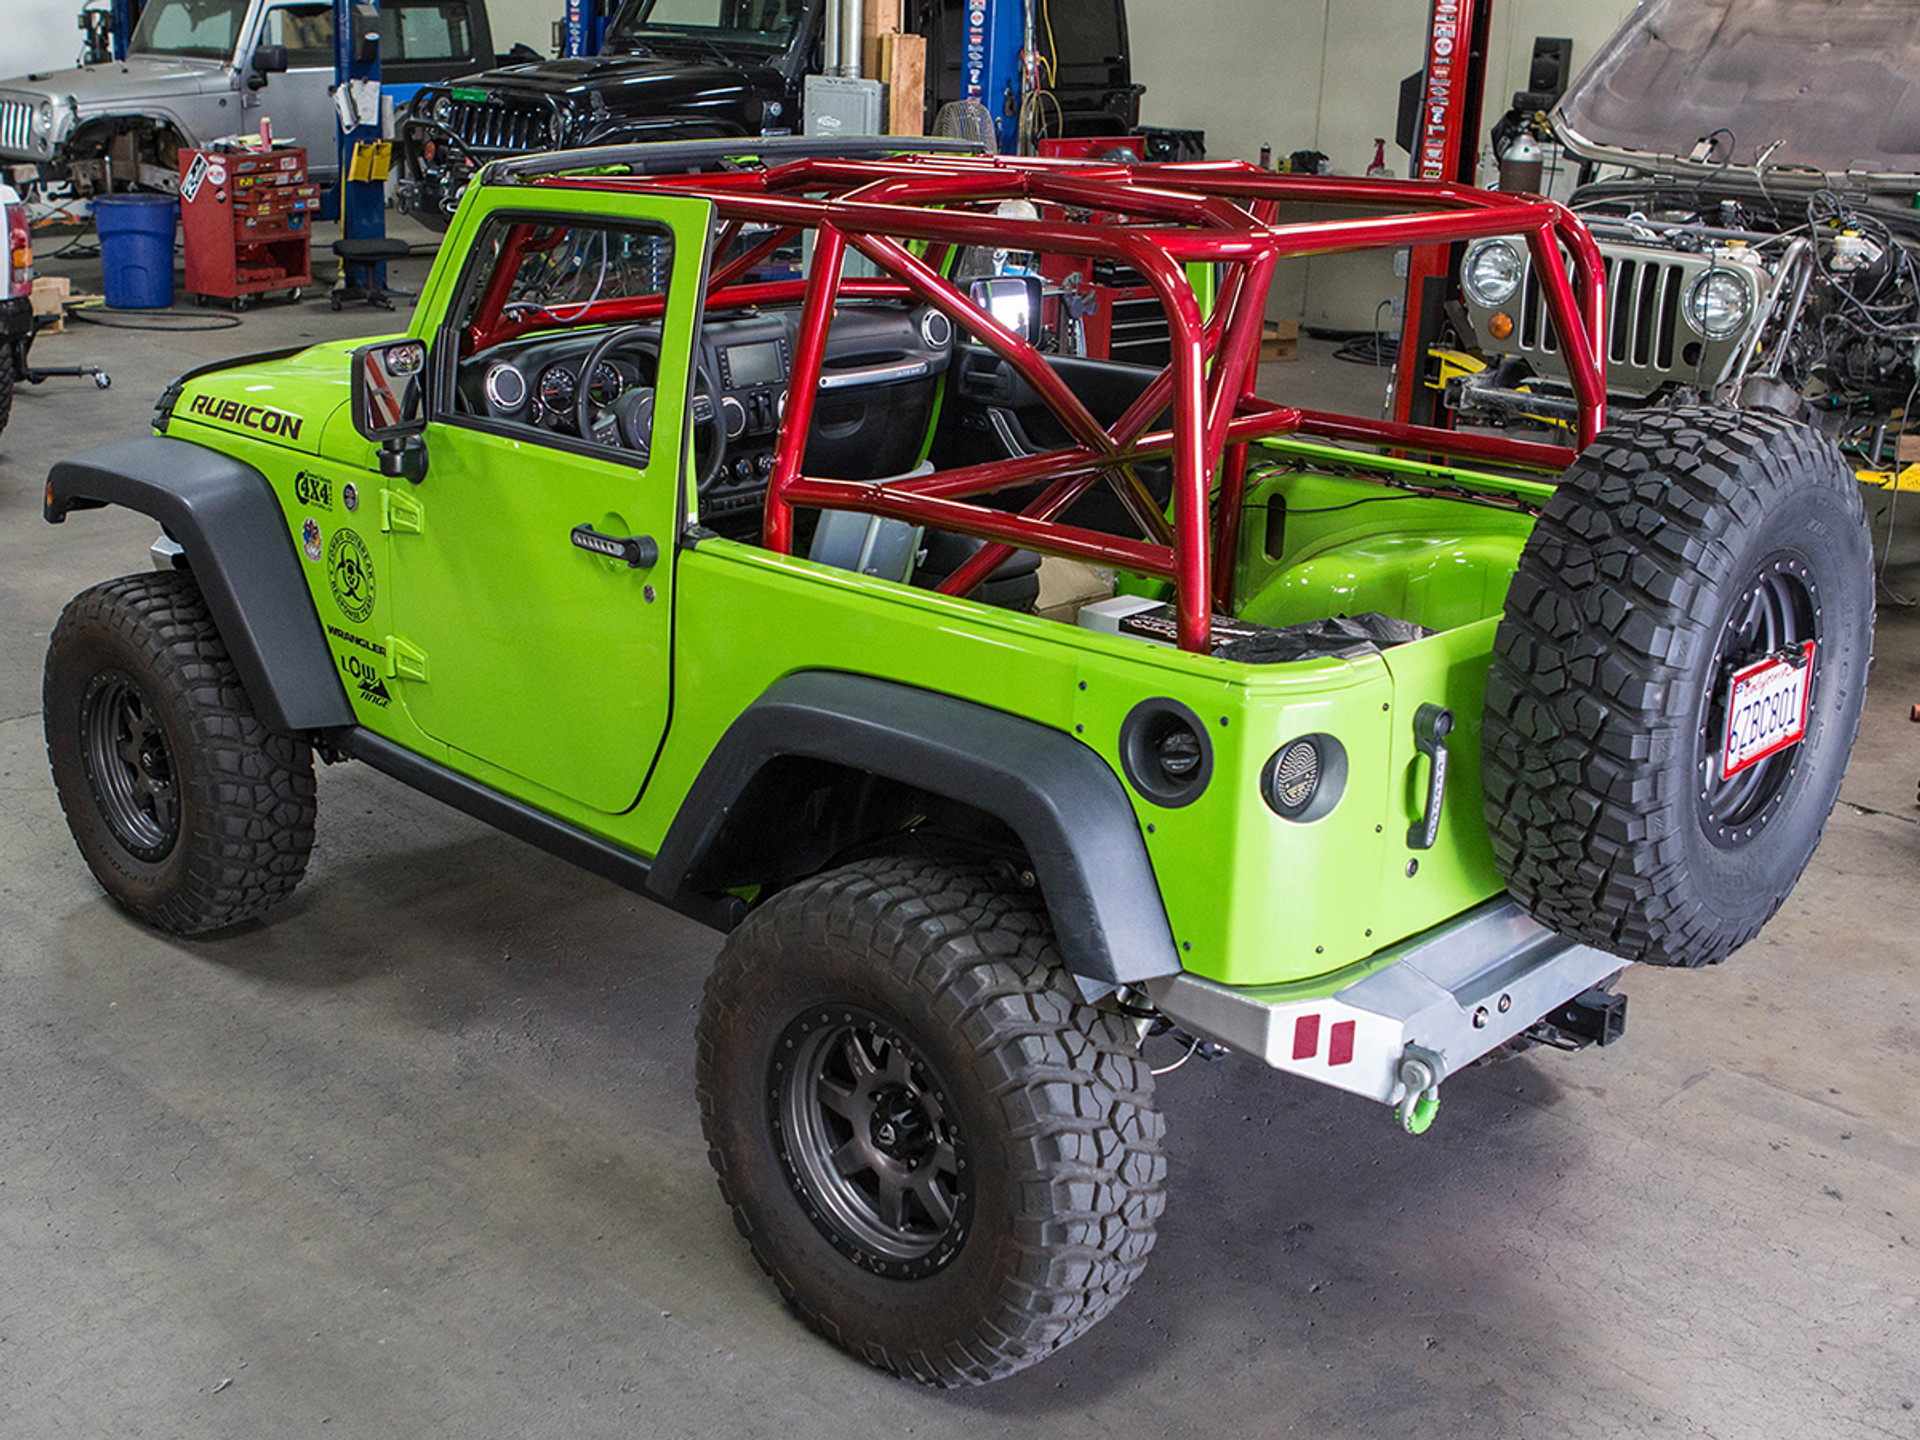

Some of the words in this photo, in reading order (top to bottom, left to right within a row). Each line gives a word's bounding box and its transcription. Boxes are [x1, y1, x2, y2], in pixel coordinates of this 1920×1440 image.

[189, 394, 304, 441] RUBICON
[326, 624, 387, 658] WRANGLER
[341, 655, 376, 681] LOW
[1728, 683, 1798, 754] 6ZBC801
